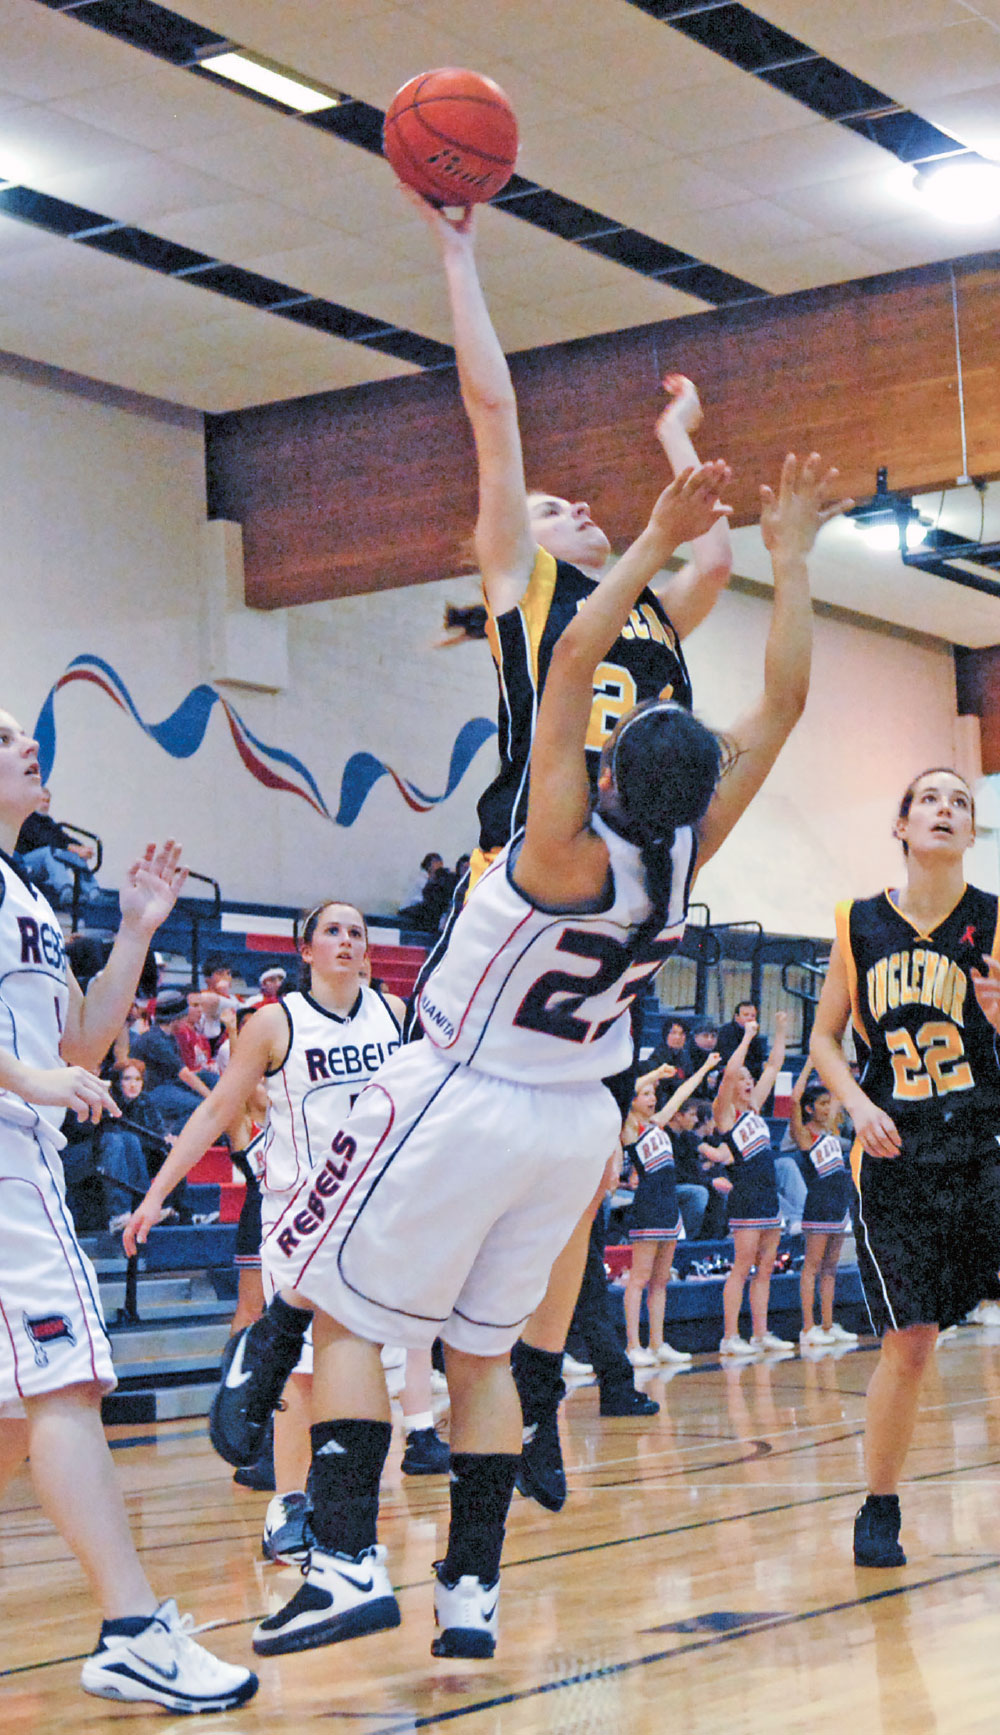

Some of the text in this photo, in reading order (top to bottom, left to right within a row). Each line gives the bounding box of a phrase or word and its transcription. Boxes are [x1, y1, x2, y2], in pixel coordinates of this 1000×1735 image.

[582, 661, 674, 752] 2
[885, 1021, 975, 1101] 22
[276, 1130, 357, 1258] REBELS
